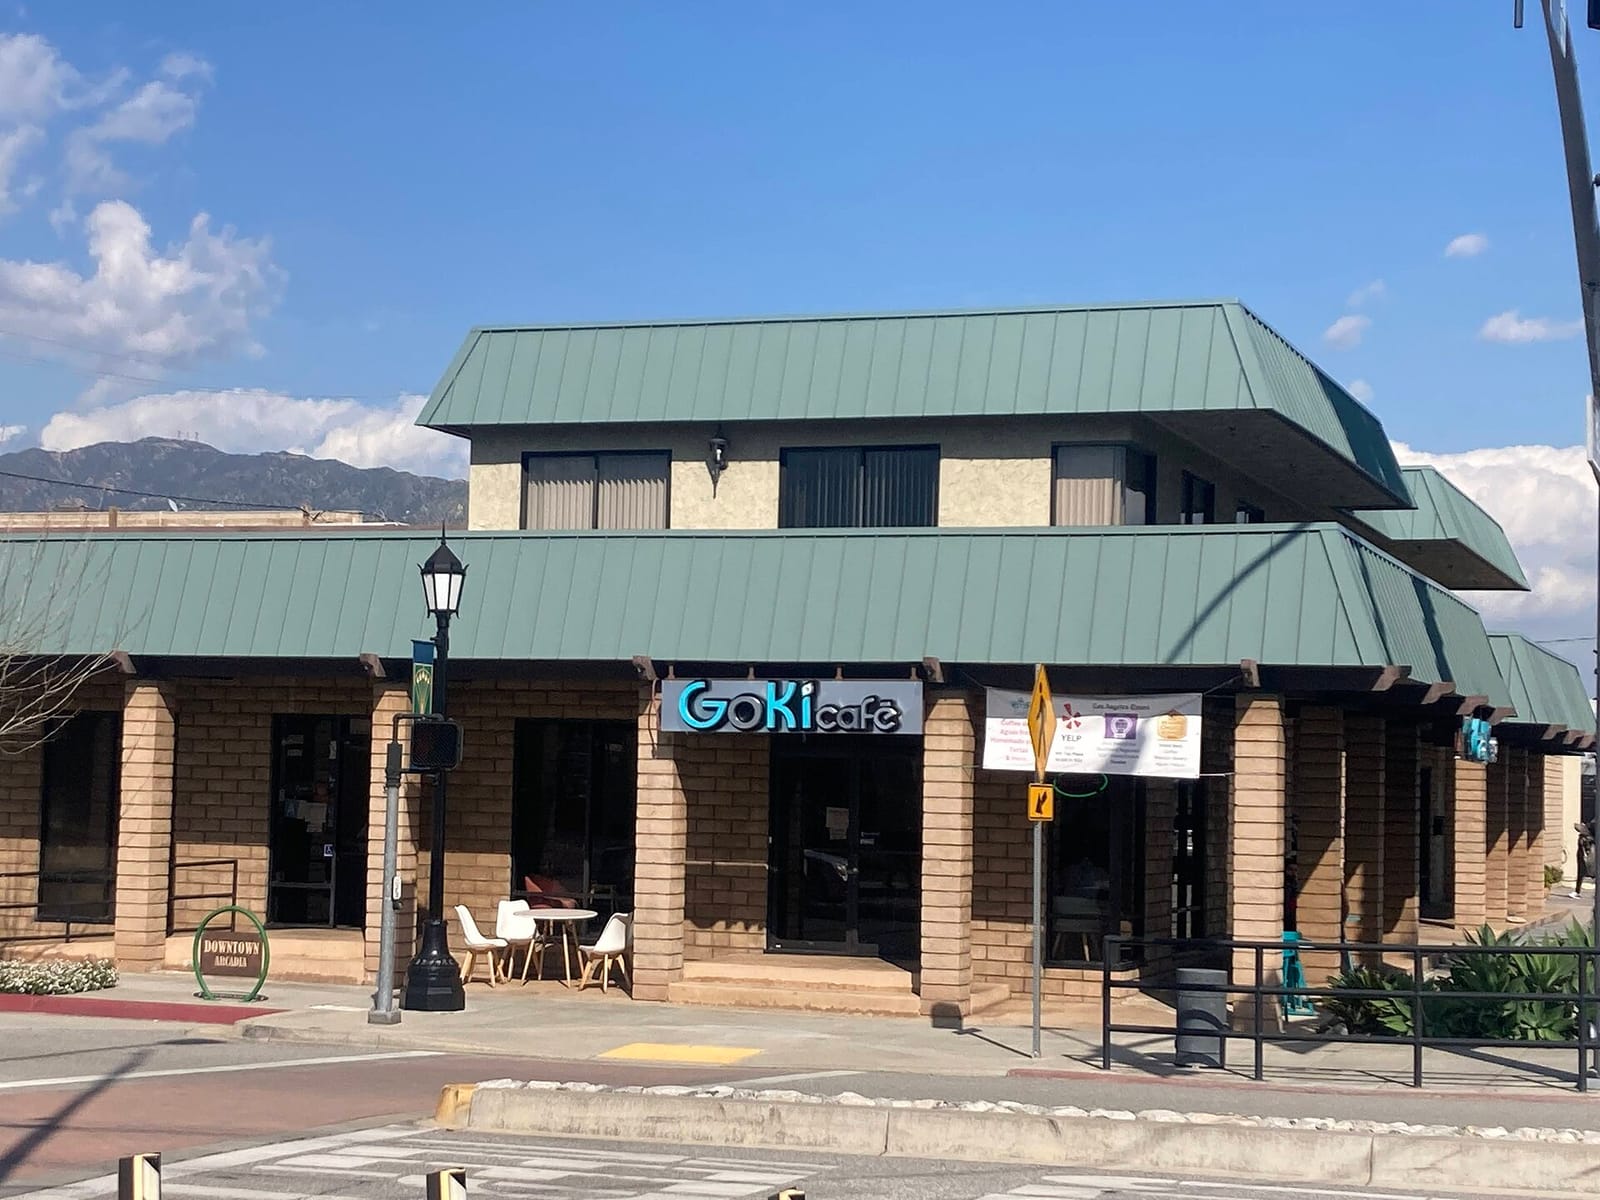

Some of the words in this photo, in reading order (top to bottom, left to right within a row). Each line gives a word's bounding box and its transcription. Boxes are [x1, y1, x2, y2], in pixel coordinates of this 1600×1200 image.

[1061, 734, 1082, 742] YELP
[204, 940, 260, 955] DOWNTOWN
[214, 956, 247, 967] ARCADIA
